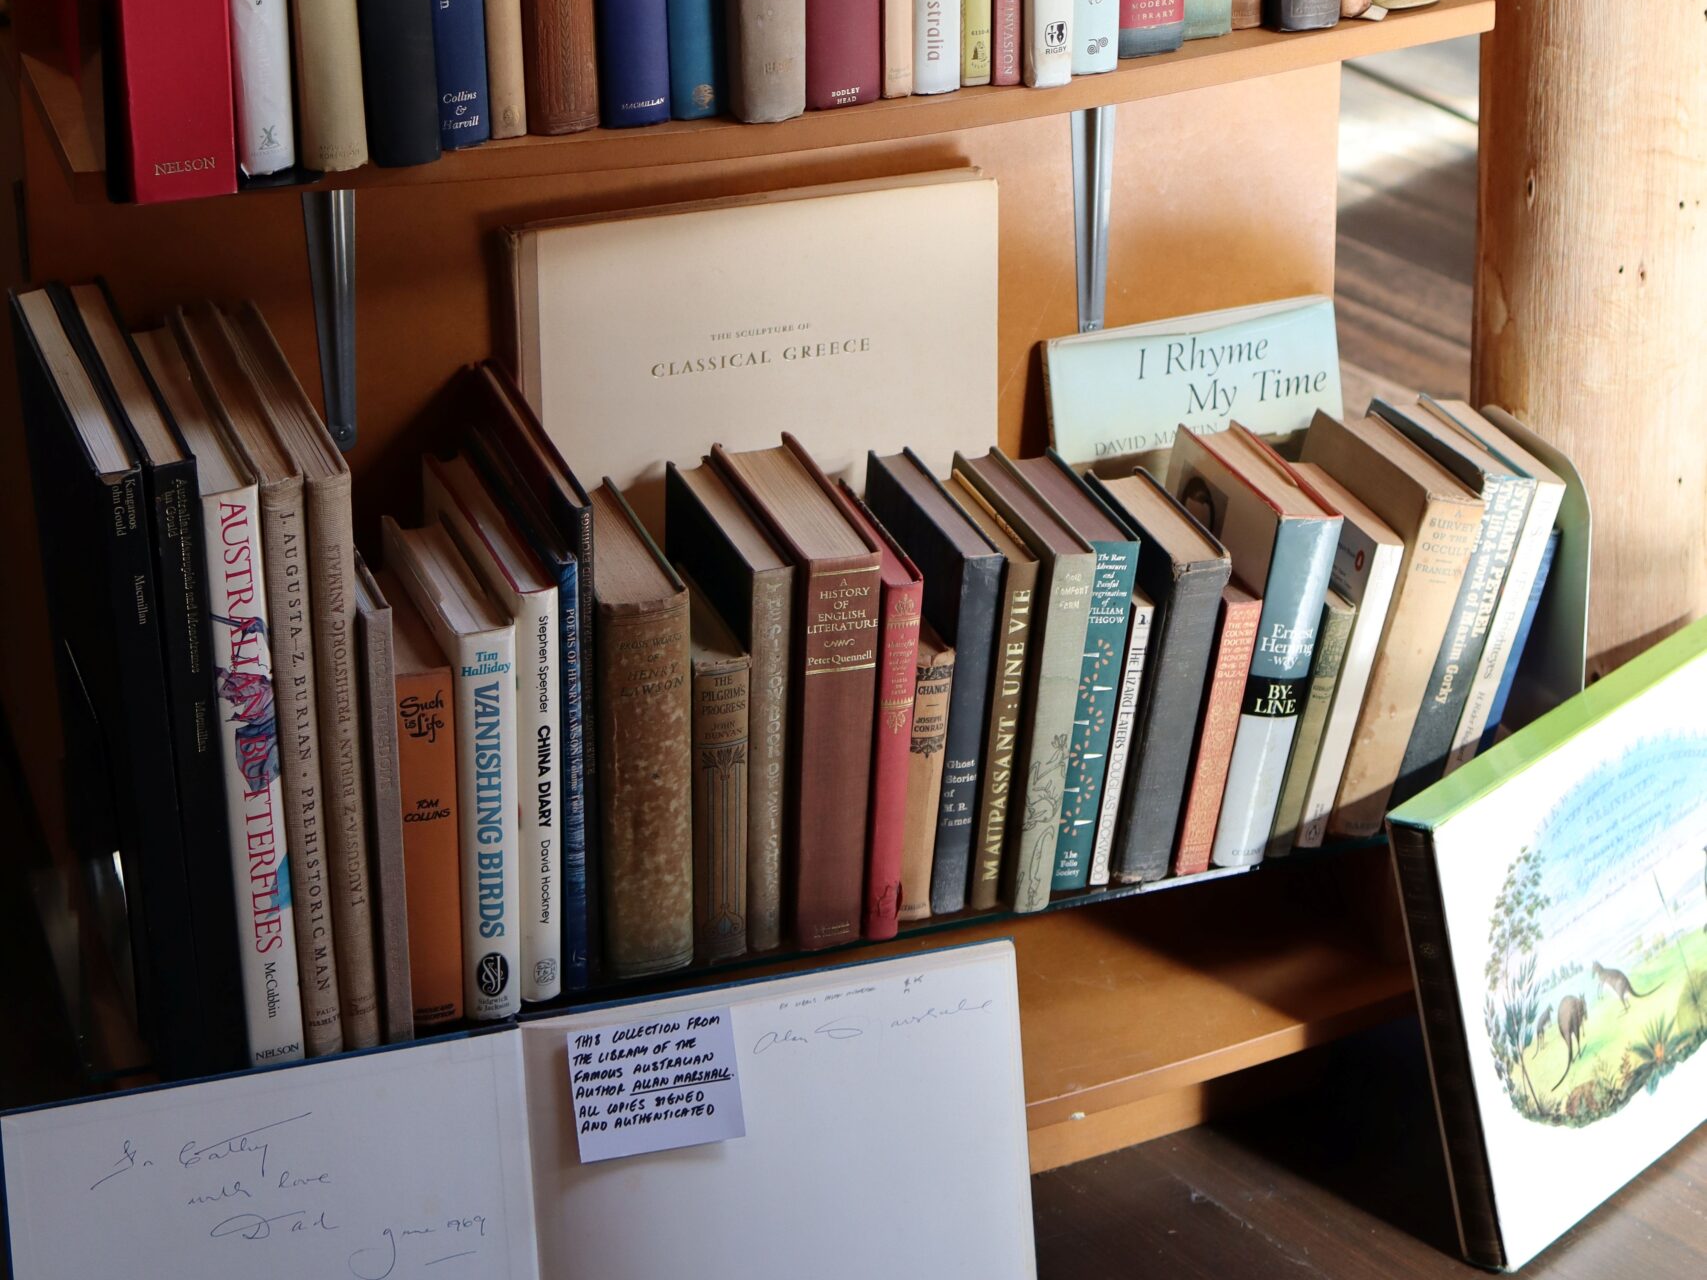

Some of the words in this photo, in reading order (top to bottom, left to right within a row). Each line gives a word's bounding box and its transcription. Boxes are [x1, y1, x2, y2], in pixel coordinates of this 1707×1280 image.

[443, 90, 477, 105] Collins
[443, 115, 479, 131] Harvill
[154, 157, 215, 176] NELSON
[651, 351, 772, 379] CLASSICAL
[783, 338, 871, 361] GREECE
[1137, 349, 1146, 380] I
[1165, 338, 1268, 376] Rhyme
[1186, 384, 1237, 418] My
[1252, 368, 1327, 403] Time
[819, 586, 870, 600] HISTORY
[219, 501, 265, 721] AUSTRALIAN
[818, 609, 867, 622] ENGLISH
[1008, 589, 1031, 629] VIE
[538, 615, 549, 663] Stephen
[808, 618, 878, 634] LITERATURE
[461, 661, 511, 677] Halliday
[476, 651, 498, 663] Tim
[808, 655, 831, 666] Peter
[832, 650, 873, 664] Quennell
[1003, 640, 1025, 696] UNE
[1131, 648, 1144, 668] THE
[538, 665, 548, 713] Spender
[714, 676, 732, 686] THE
[918, 685, 949, 695] CHANCE
[1123, 669, 1142, 709] LIZARD
[1268, 684, 1292, 700] BY-
[400, 693, 444, 715] Such
[702, 703, 746, 717] PROGRESS
[1255, 699, 1296, 714] LINE
[1114, 712, 1135, 749] EATERS
[474, 680, 504, 846] VANISHING
[537, 724, 551, 777] CHINA
[947, 758, 975, 769] Ghost
[1105, 753, 1123, 810] DOUGLAS
[415, 799, 438, 810] TOM
[538, 781, 551, 828] DIARY
[984, 716, 1016, 880] MAUPASSANT
[404, 808, 452, 824] COLLINS
[944, 816, 972, 827] James
[239, 734, 283, 955] BUTTERFLIES
[540, 840, 550, 872] David
[1092, 814, 1113, 881] LOCKWOOD
[477, 850, 505, 939] BIRDS
[540, 877, 550, 924] Hockney
[265, 962, 278, 1019] McCubbin
[575, 1034, 601, 1050] THIS
[612, 1022, 680, 1043] COLLECTION
[687, 1016, 720, 1030] FROM
[256, 1043, 299, 1060] NELSON
[573, 1052, 592, 1066] THE
[598, 1046, 648, 1063] LIBRARY
[653, 1042, 670, 1055] OF
[676, 1038, 697, 1051] THE
[574, 1068, 623, 1083] FAMOUS
[633, 1052, 714, 1074] AUSTRALIAN
[576, 1084, 625, 1099] AUTHOR
[633, 1077, 669, 1092] ALLAN
[580, 1105, 599, 1118] ALL
[607, 1099, 645, 1114] COPIES
[655, 1091, 704, 1106] SIGNED
[581, 1121, 607, 1134] AND
[615, 1104, 714, 1130] AUTHENTICATED
